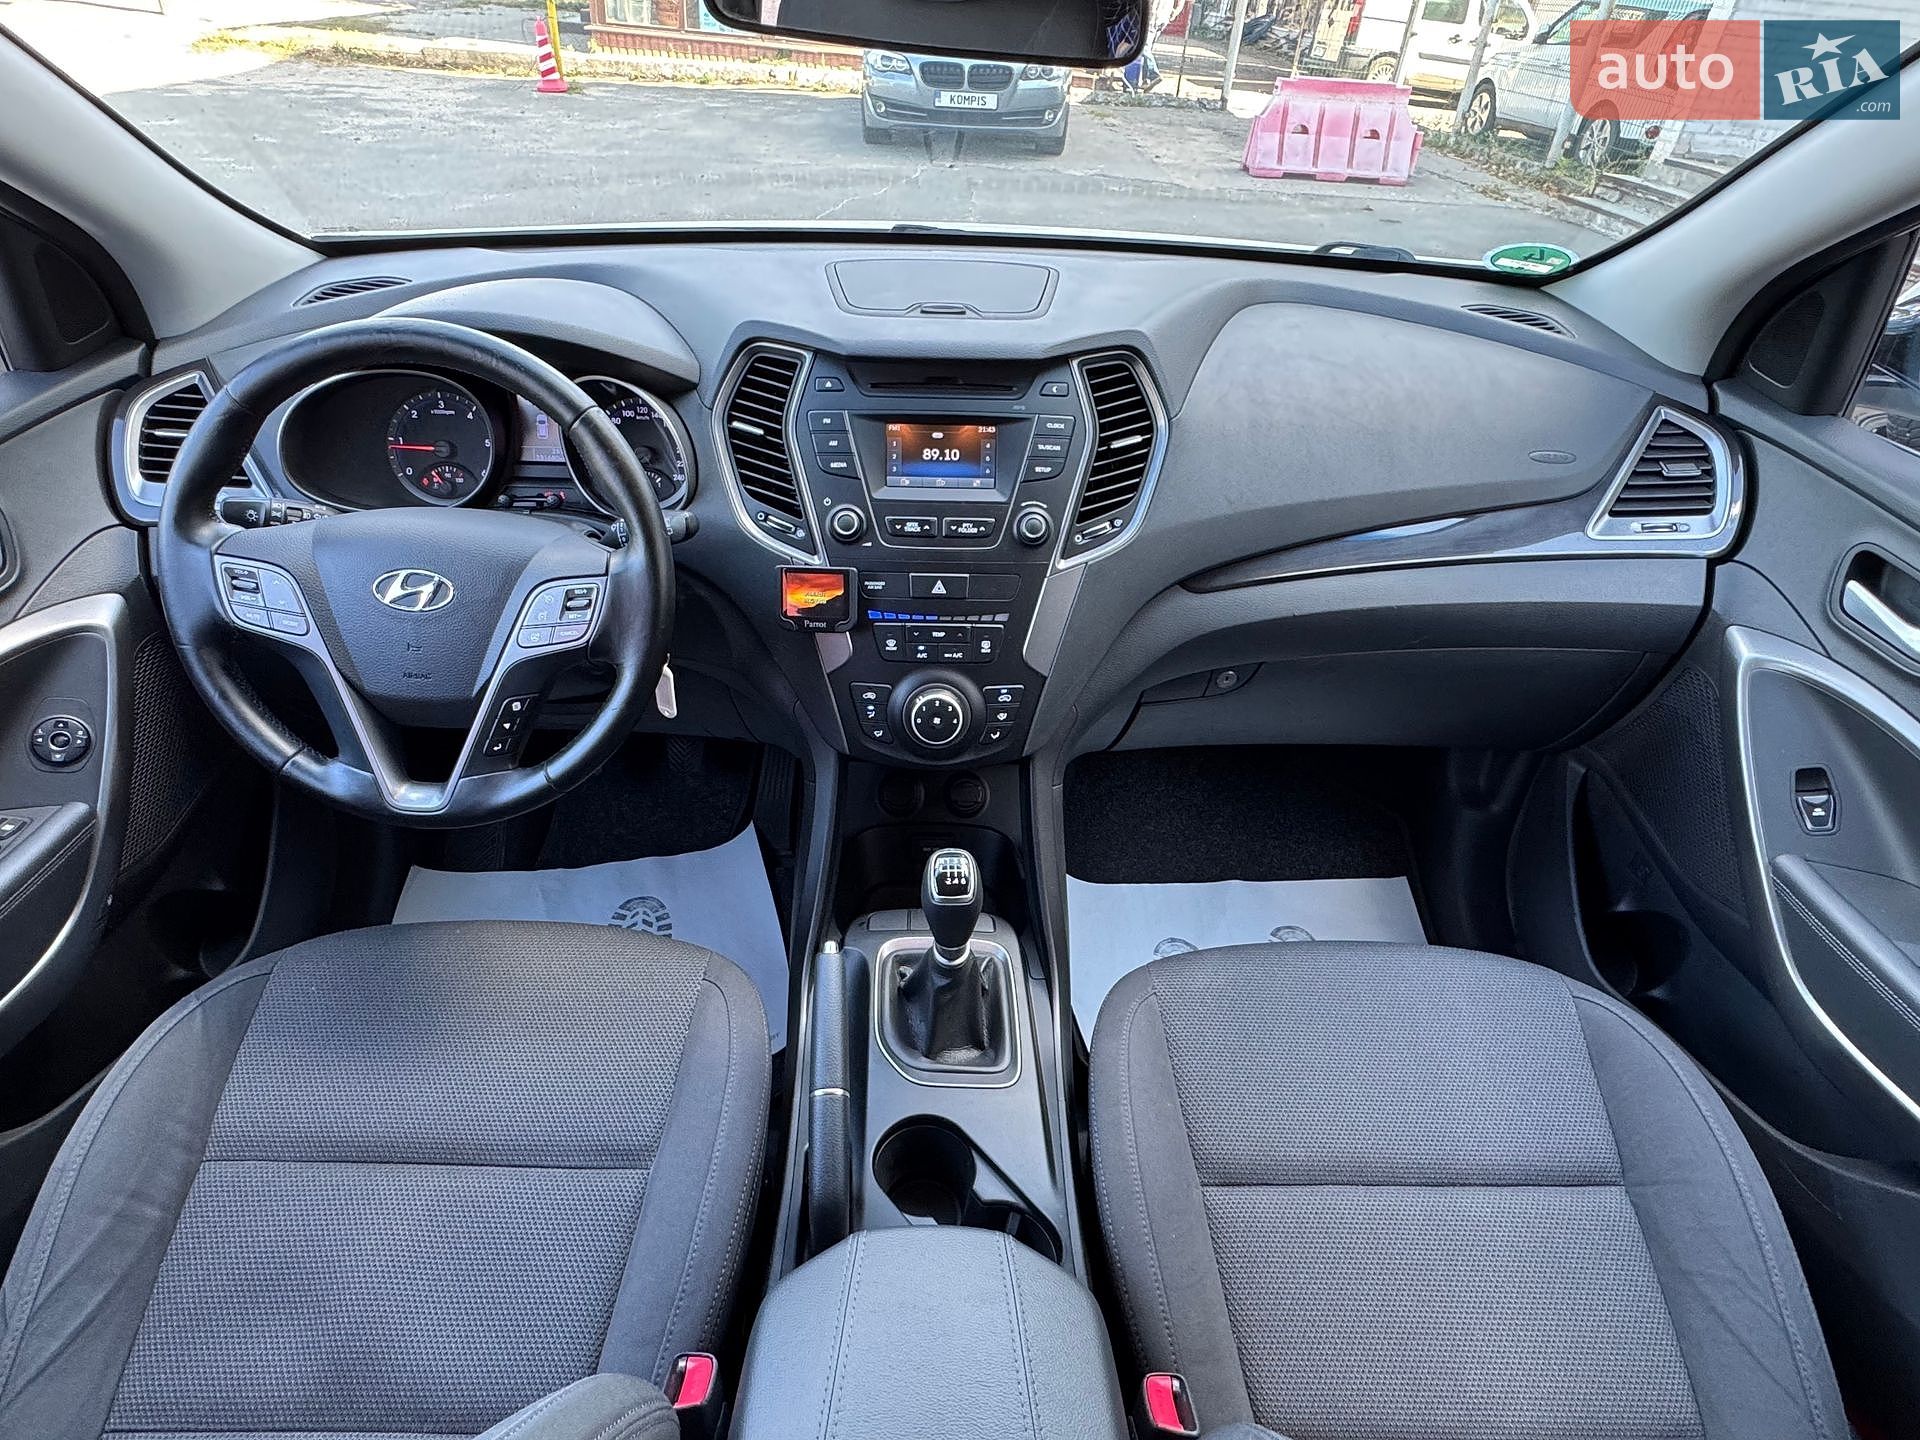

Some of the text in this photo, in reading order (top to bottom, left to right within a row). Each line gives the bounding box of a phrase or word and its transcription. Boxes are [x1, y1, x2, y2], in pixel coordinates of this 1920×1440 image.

[950, 94, 987, 106] KOMPIS
[636, 406, 648, 414] 120
[922, 448, 960, 461] 89.10
[804, 620, 827, 628] Parrot
